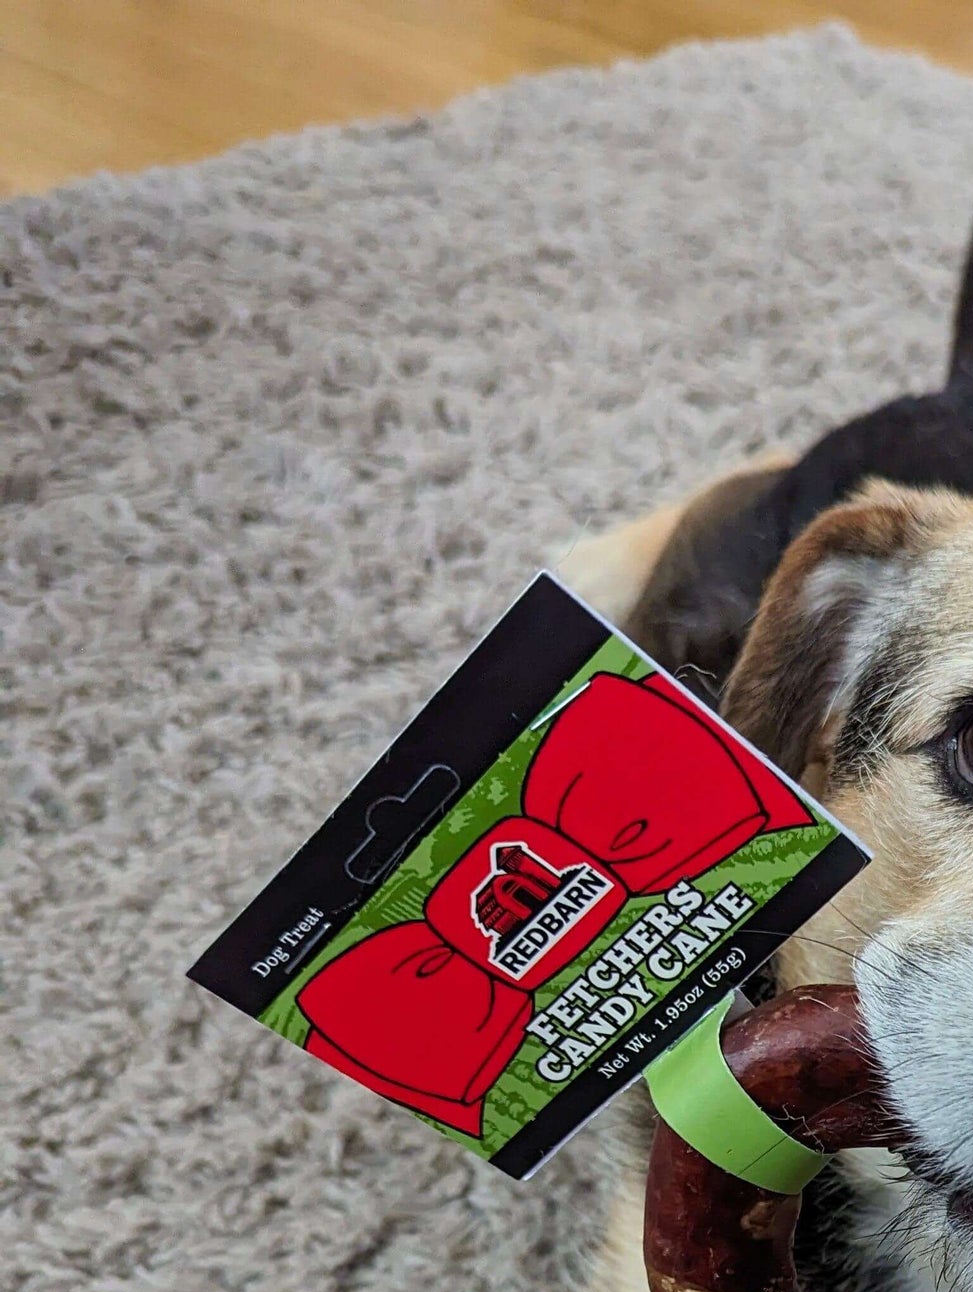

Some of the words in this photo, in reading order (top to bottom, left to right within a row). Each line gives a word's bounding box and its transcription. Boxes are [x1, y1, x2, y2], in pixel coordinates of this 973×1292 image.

[251, 946, 290, 978] Dog
[279, 907, 324, 947] Treat
[498, 870, 608, 975] REDBARN
[525, 880, 703, 1045] FETCHERS
[536, 974, 654, 1082] CANDY
[647, 884, 754, 980] CANE
[597, 1055, 630, 1079] Net
[624, 1031, 657, 1054] Wt.
[654, 985, 705, 1031] 1.95oz
[701, 947, 747, 988] (55g)
